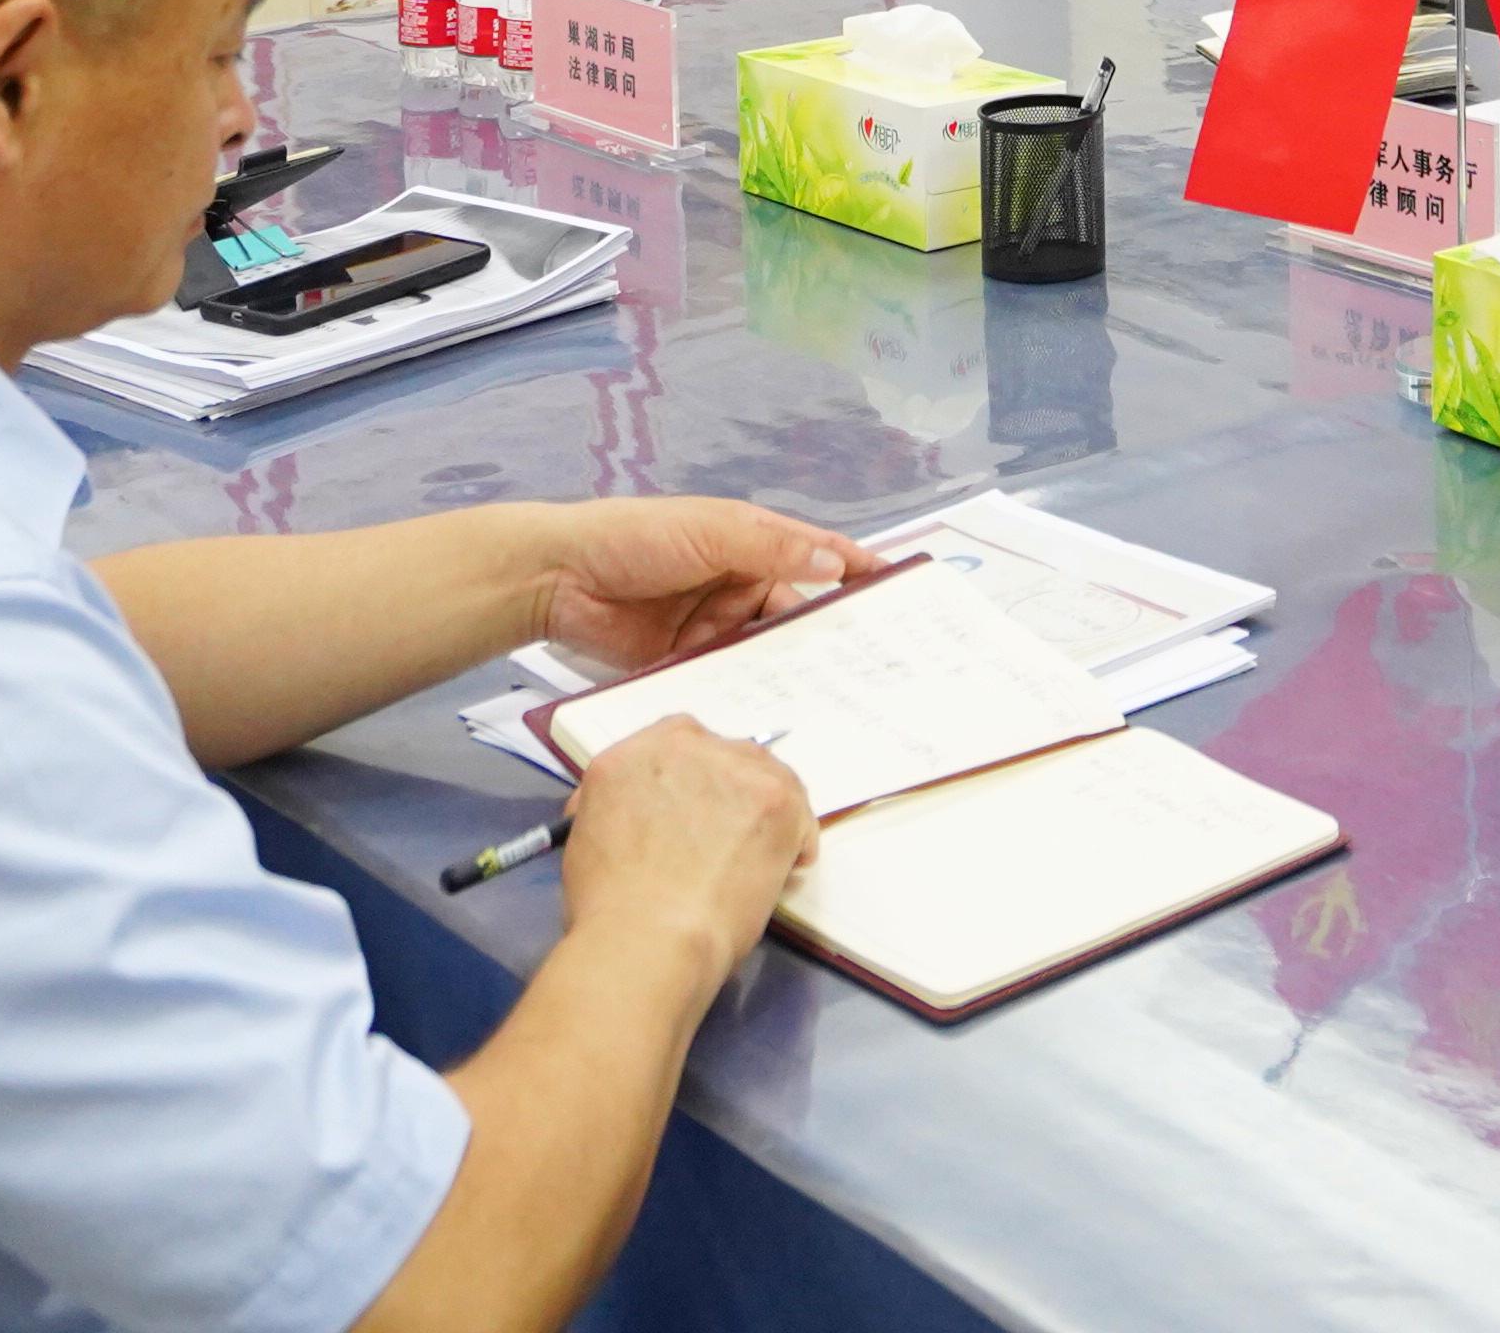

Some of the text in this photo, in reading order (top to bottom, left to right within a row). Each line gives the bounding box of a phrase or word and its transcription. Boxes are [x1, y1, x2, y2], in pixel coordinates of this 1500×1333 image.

[568, 19, 636, 63] 巢湖市局
[568, 55, 637, 99] 法律顾问
